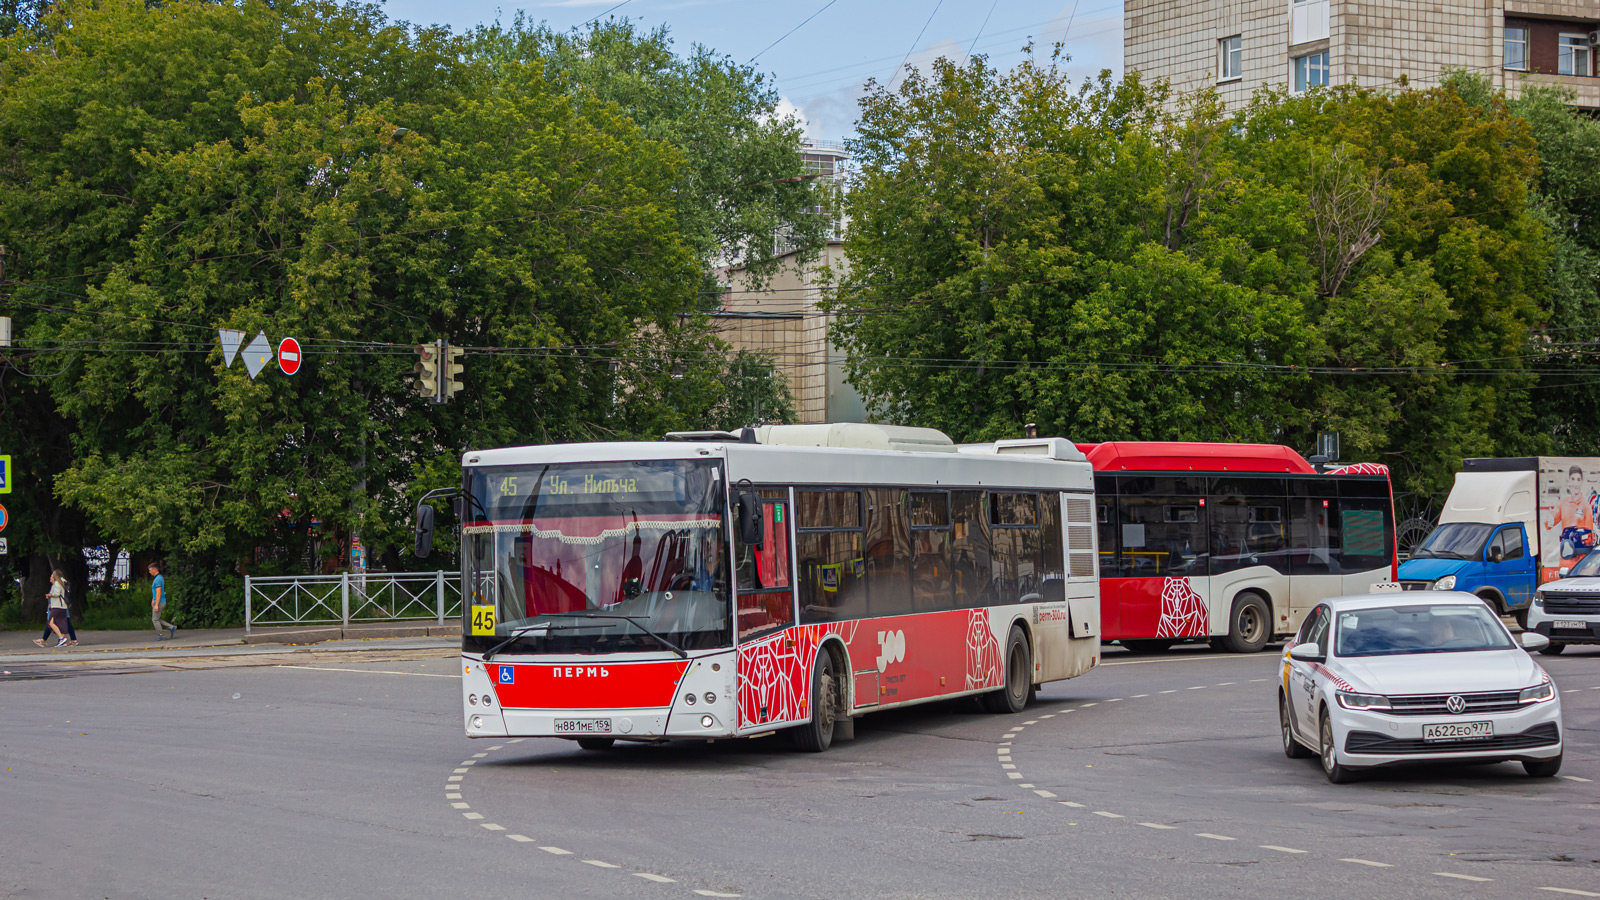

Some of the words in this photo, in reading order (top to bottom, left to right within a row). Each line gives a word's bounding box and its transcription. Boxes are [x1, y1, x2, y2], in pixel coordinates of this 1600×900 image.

[500, 477, 517, 496] 45
[550, 475, 574, 495] Ул.
[584, 474, 640, 494] Мильча
[473, 612, 494, 631] 45
[553, 667, 609, 678] ПЕРМЬ
[1472, 722, 1490, 732] 977
